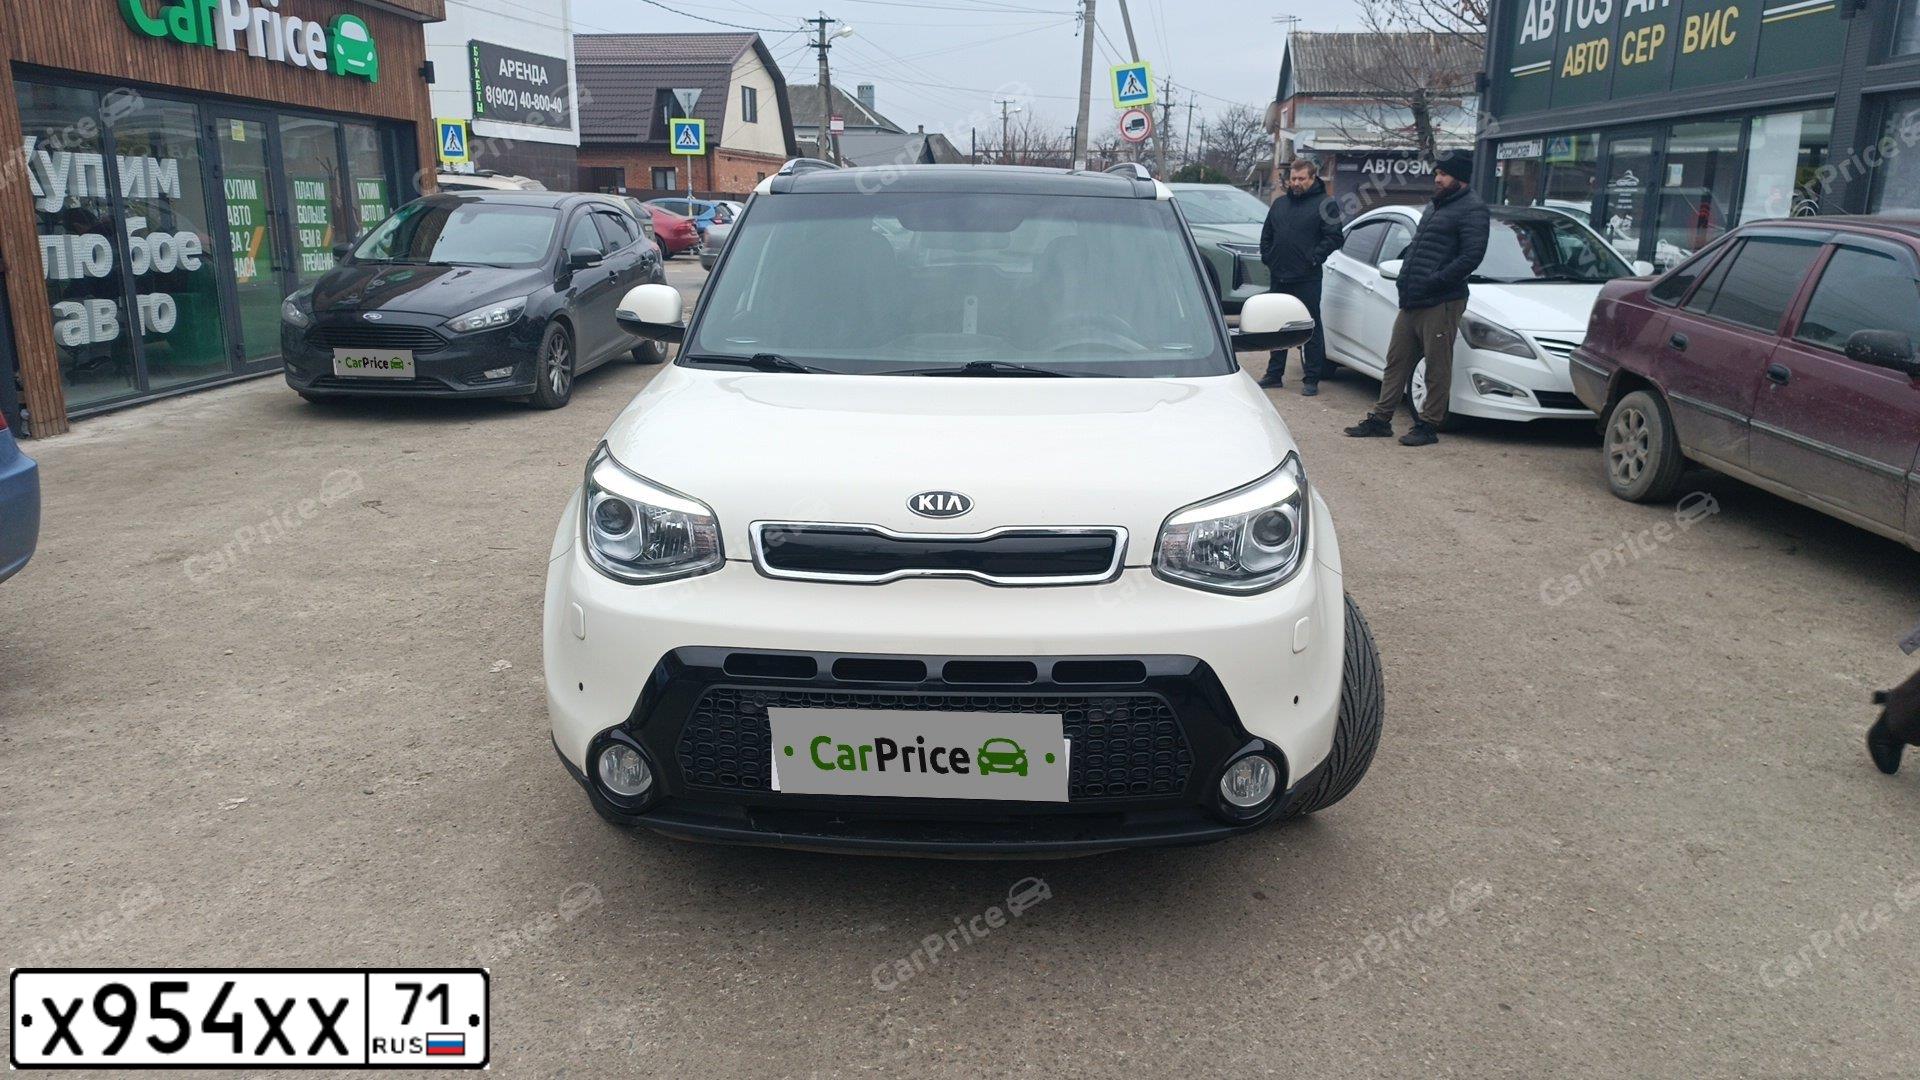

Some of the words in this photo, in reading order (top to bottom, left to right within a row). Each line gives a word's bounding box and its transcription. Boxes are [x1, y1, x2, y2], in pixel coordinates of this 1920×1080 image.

[120, 0, 328, 71] CarPrice
[1561, 37, 1609, 78] АВТО
[1621, 23, 1666, 66] СЕР
[1683, 6, 1739, 54] ВИС
[473, 46, 484, 113] БУКЕТЫ
[499, 58, 548, 86] АРЕНДА
[485, 85, 518, 111] 8(902)
[520, 91, 562, 113] 40-800-40
[224, 179, 257, 200] КУПИМ
[294, 181, 326, 200] ПЛАТИМ
[227, 205, 252, 226] АВТО
[297, 205, 327, 224] БОЛЬШЕ
[918, 494, 963, 511] KIA
